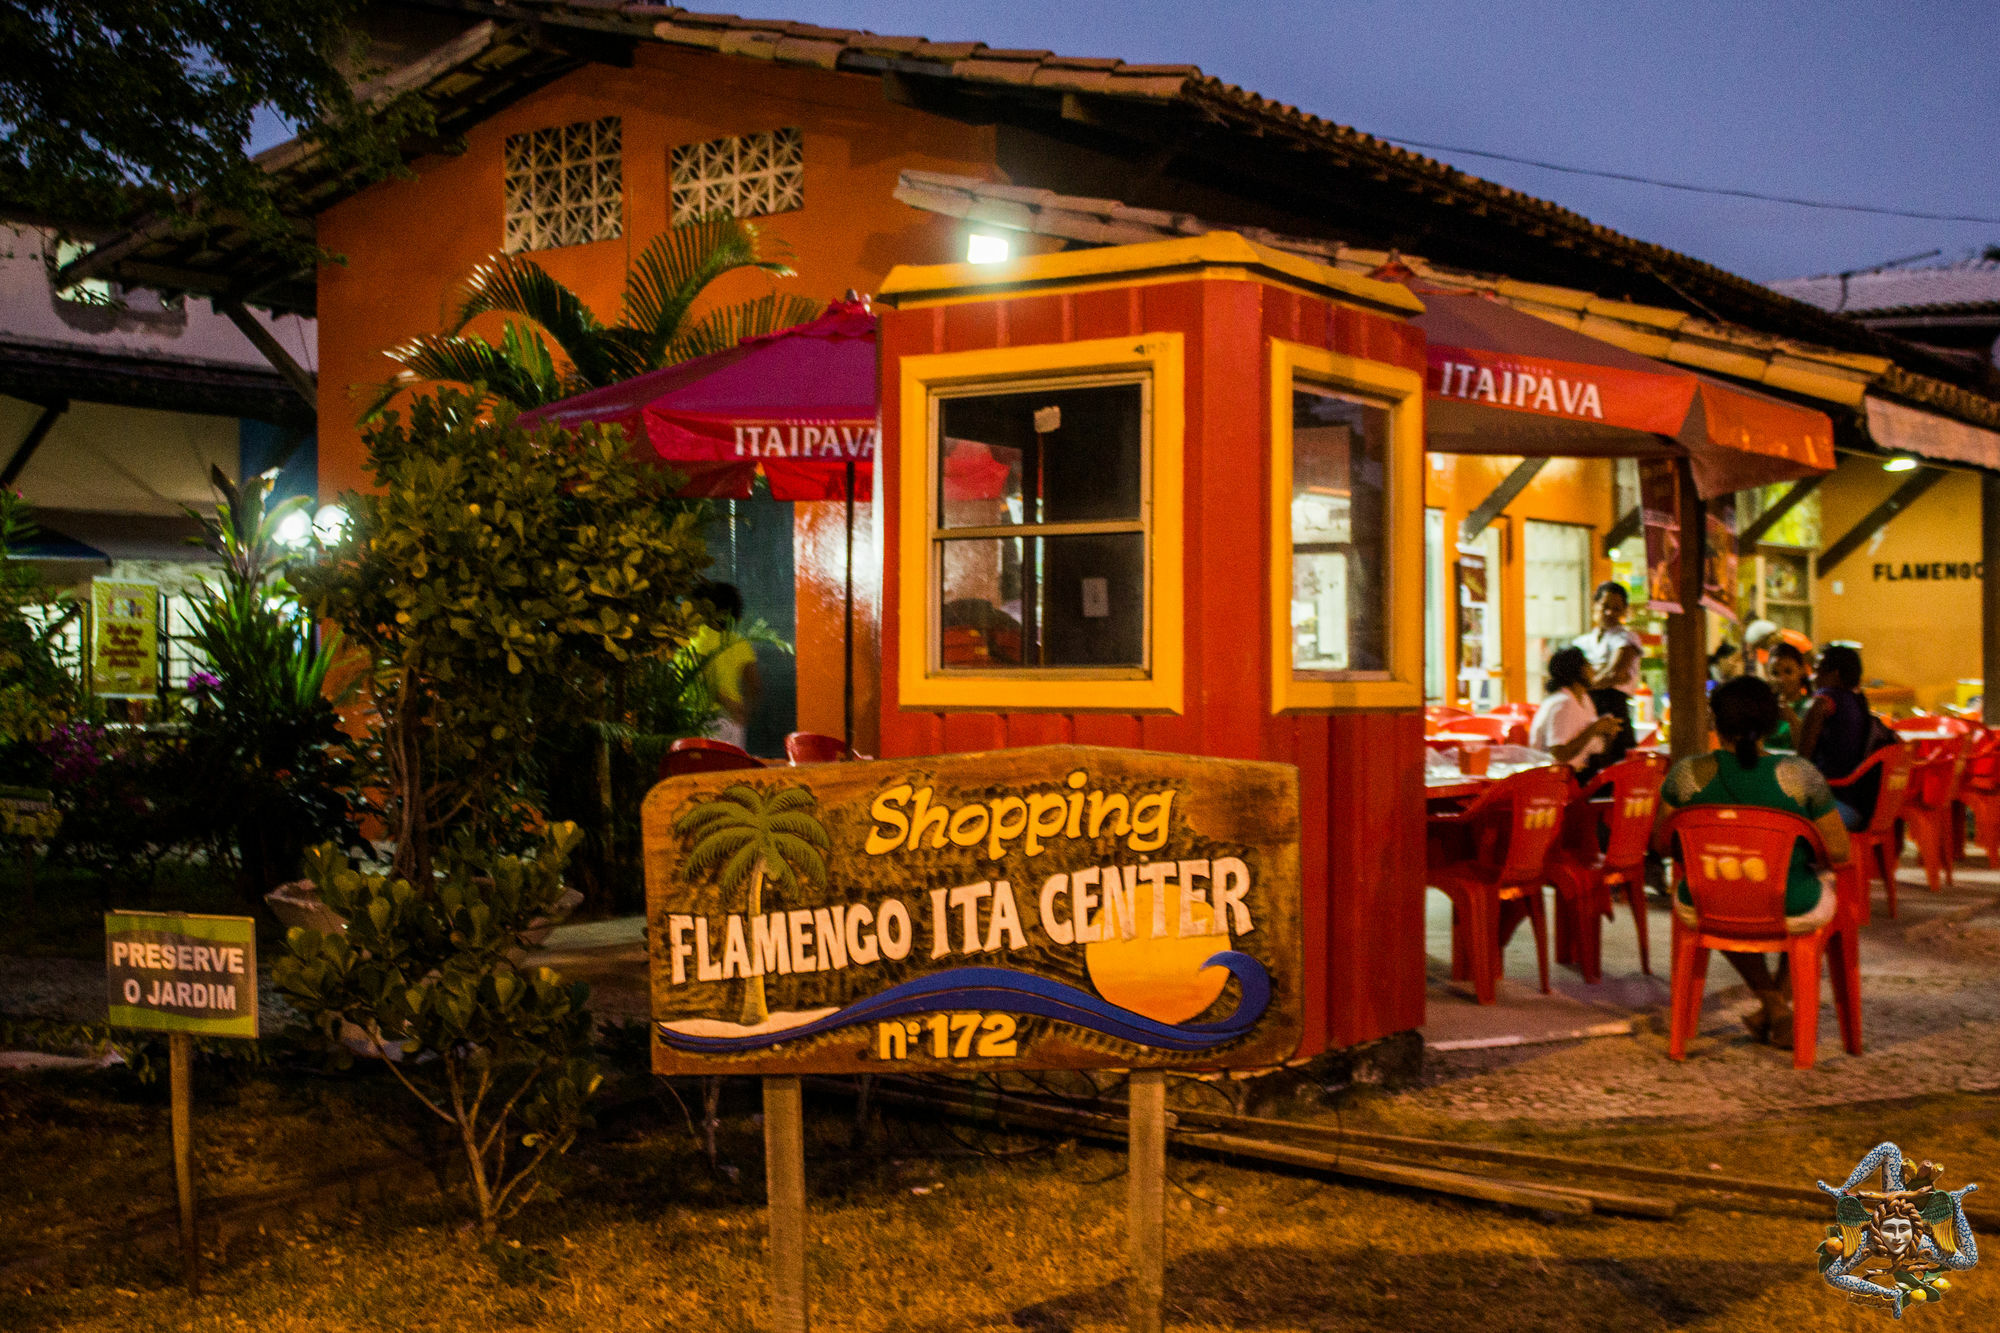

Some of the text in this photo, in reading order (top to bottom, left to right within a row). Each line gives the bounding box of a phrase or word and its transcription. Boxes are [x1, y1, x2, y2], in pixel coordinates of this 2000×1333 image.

[1440, 361, 1603, 418] ITAIPAVA
[866, 772, 1177, 860] Shopping
[669, 857, 1254, 984] FLAMENGO ITA CENTER
[113, 942, 243, 974] PRESERVE
[125, 979, 236, 1010] O JARDIM
